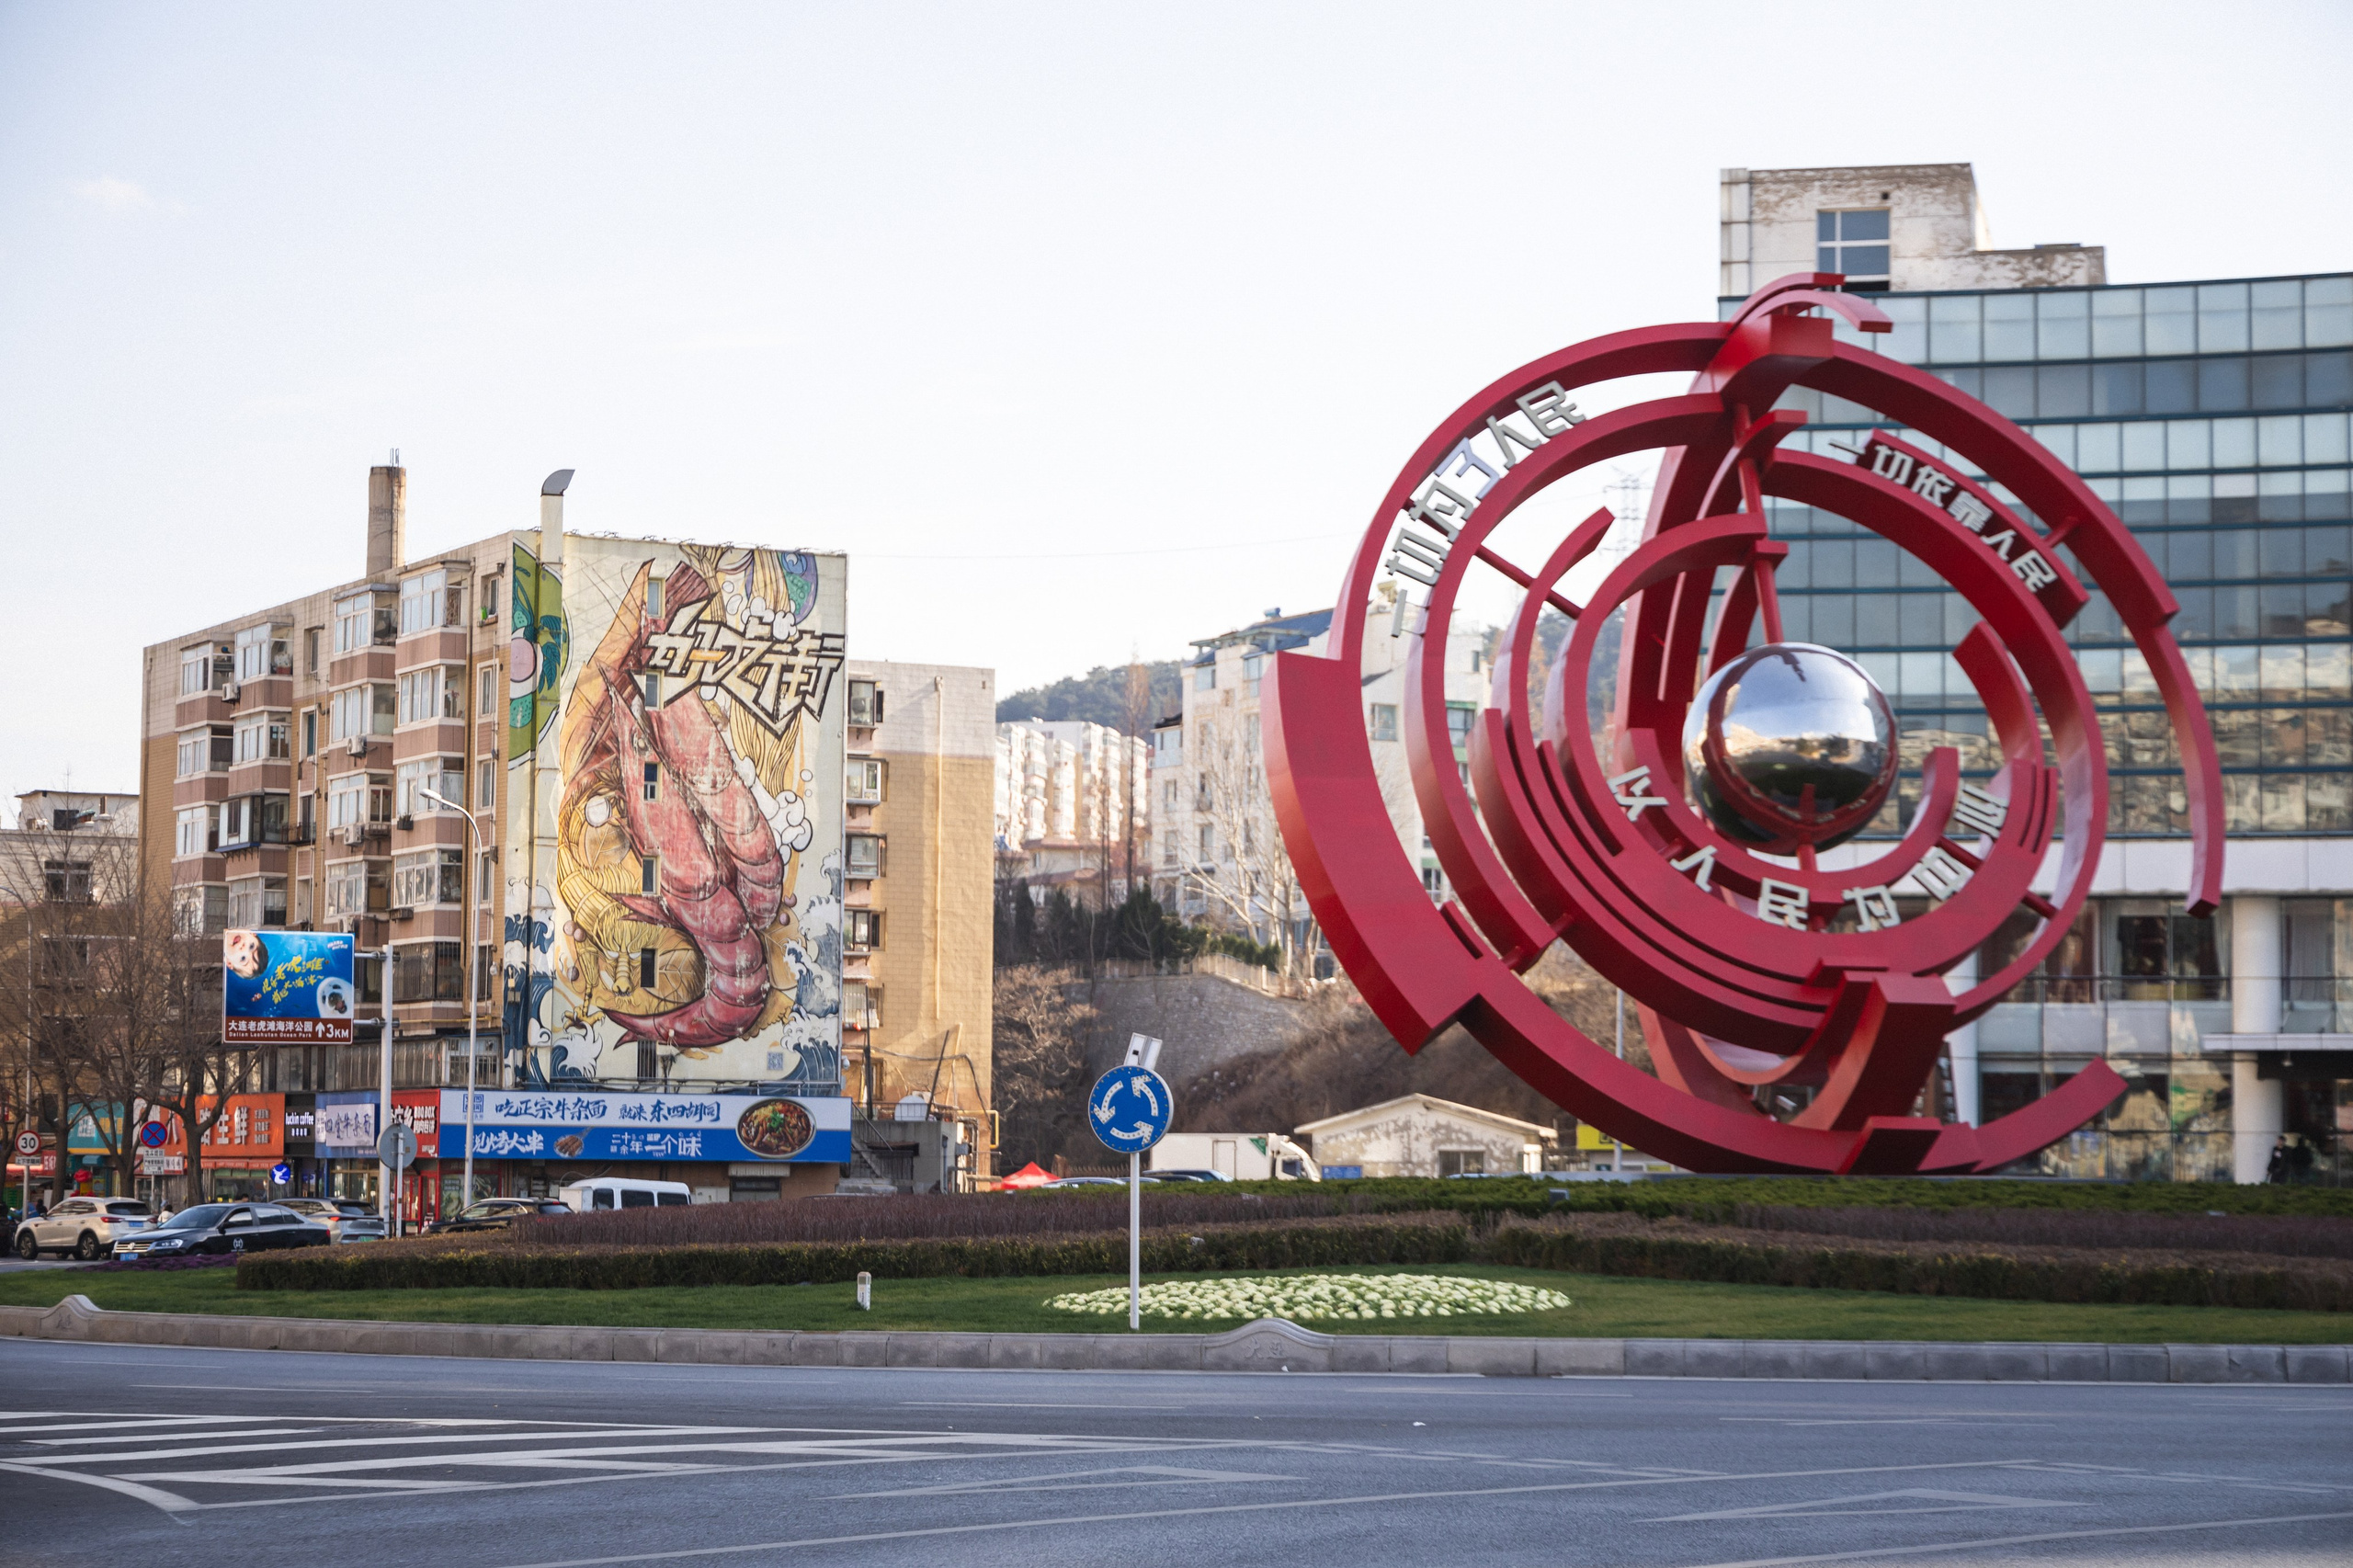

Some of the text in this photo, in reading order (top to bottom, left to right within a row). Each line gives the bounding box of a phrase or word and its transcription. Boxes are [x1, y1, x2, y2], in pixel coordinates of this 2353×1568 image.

[1385, 380, 1586, 638] 一切为了人民
[1828, 439, 2058, 593] 一切依靠人民
[1607, 766, 2009, 932] 以人民为中心
[228, 1020, 313, 1031] 大连老虎滩海洋公园
[325, 1024, 349, 1039] 3KM
[285, 1111, 300, 1125] luckin
[300, 1111, 314, 1125] coffee
[495, 1096, 721, 1122] 吃正宗牛杂面 就来东四胡同
[20, 1138, 36, 1149] 30
